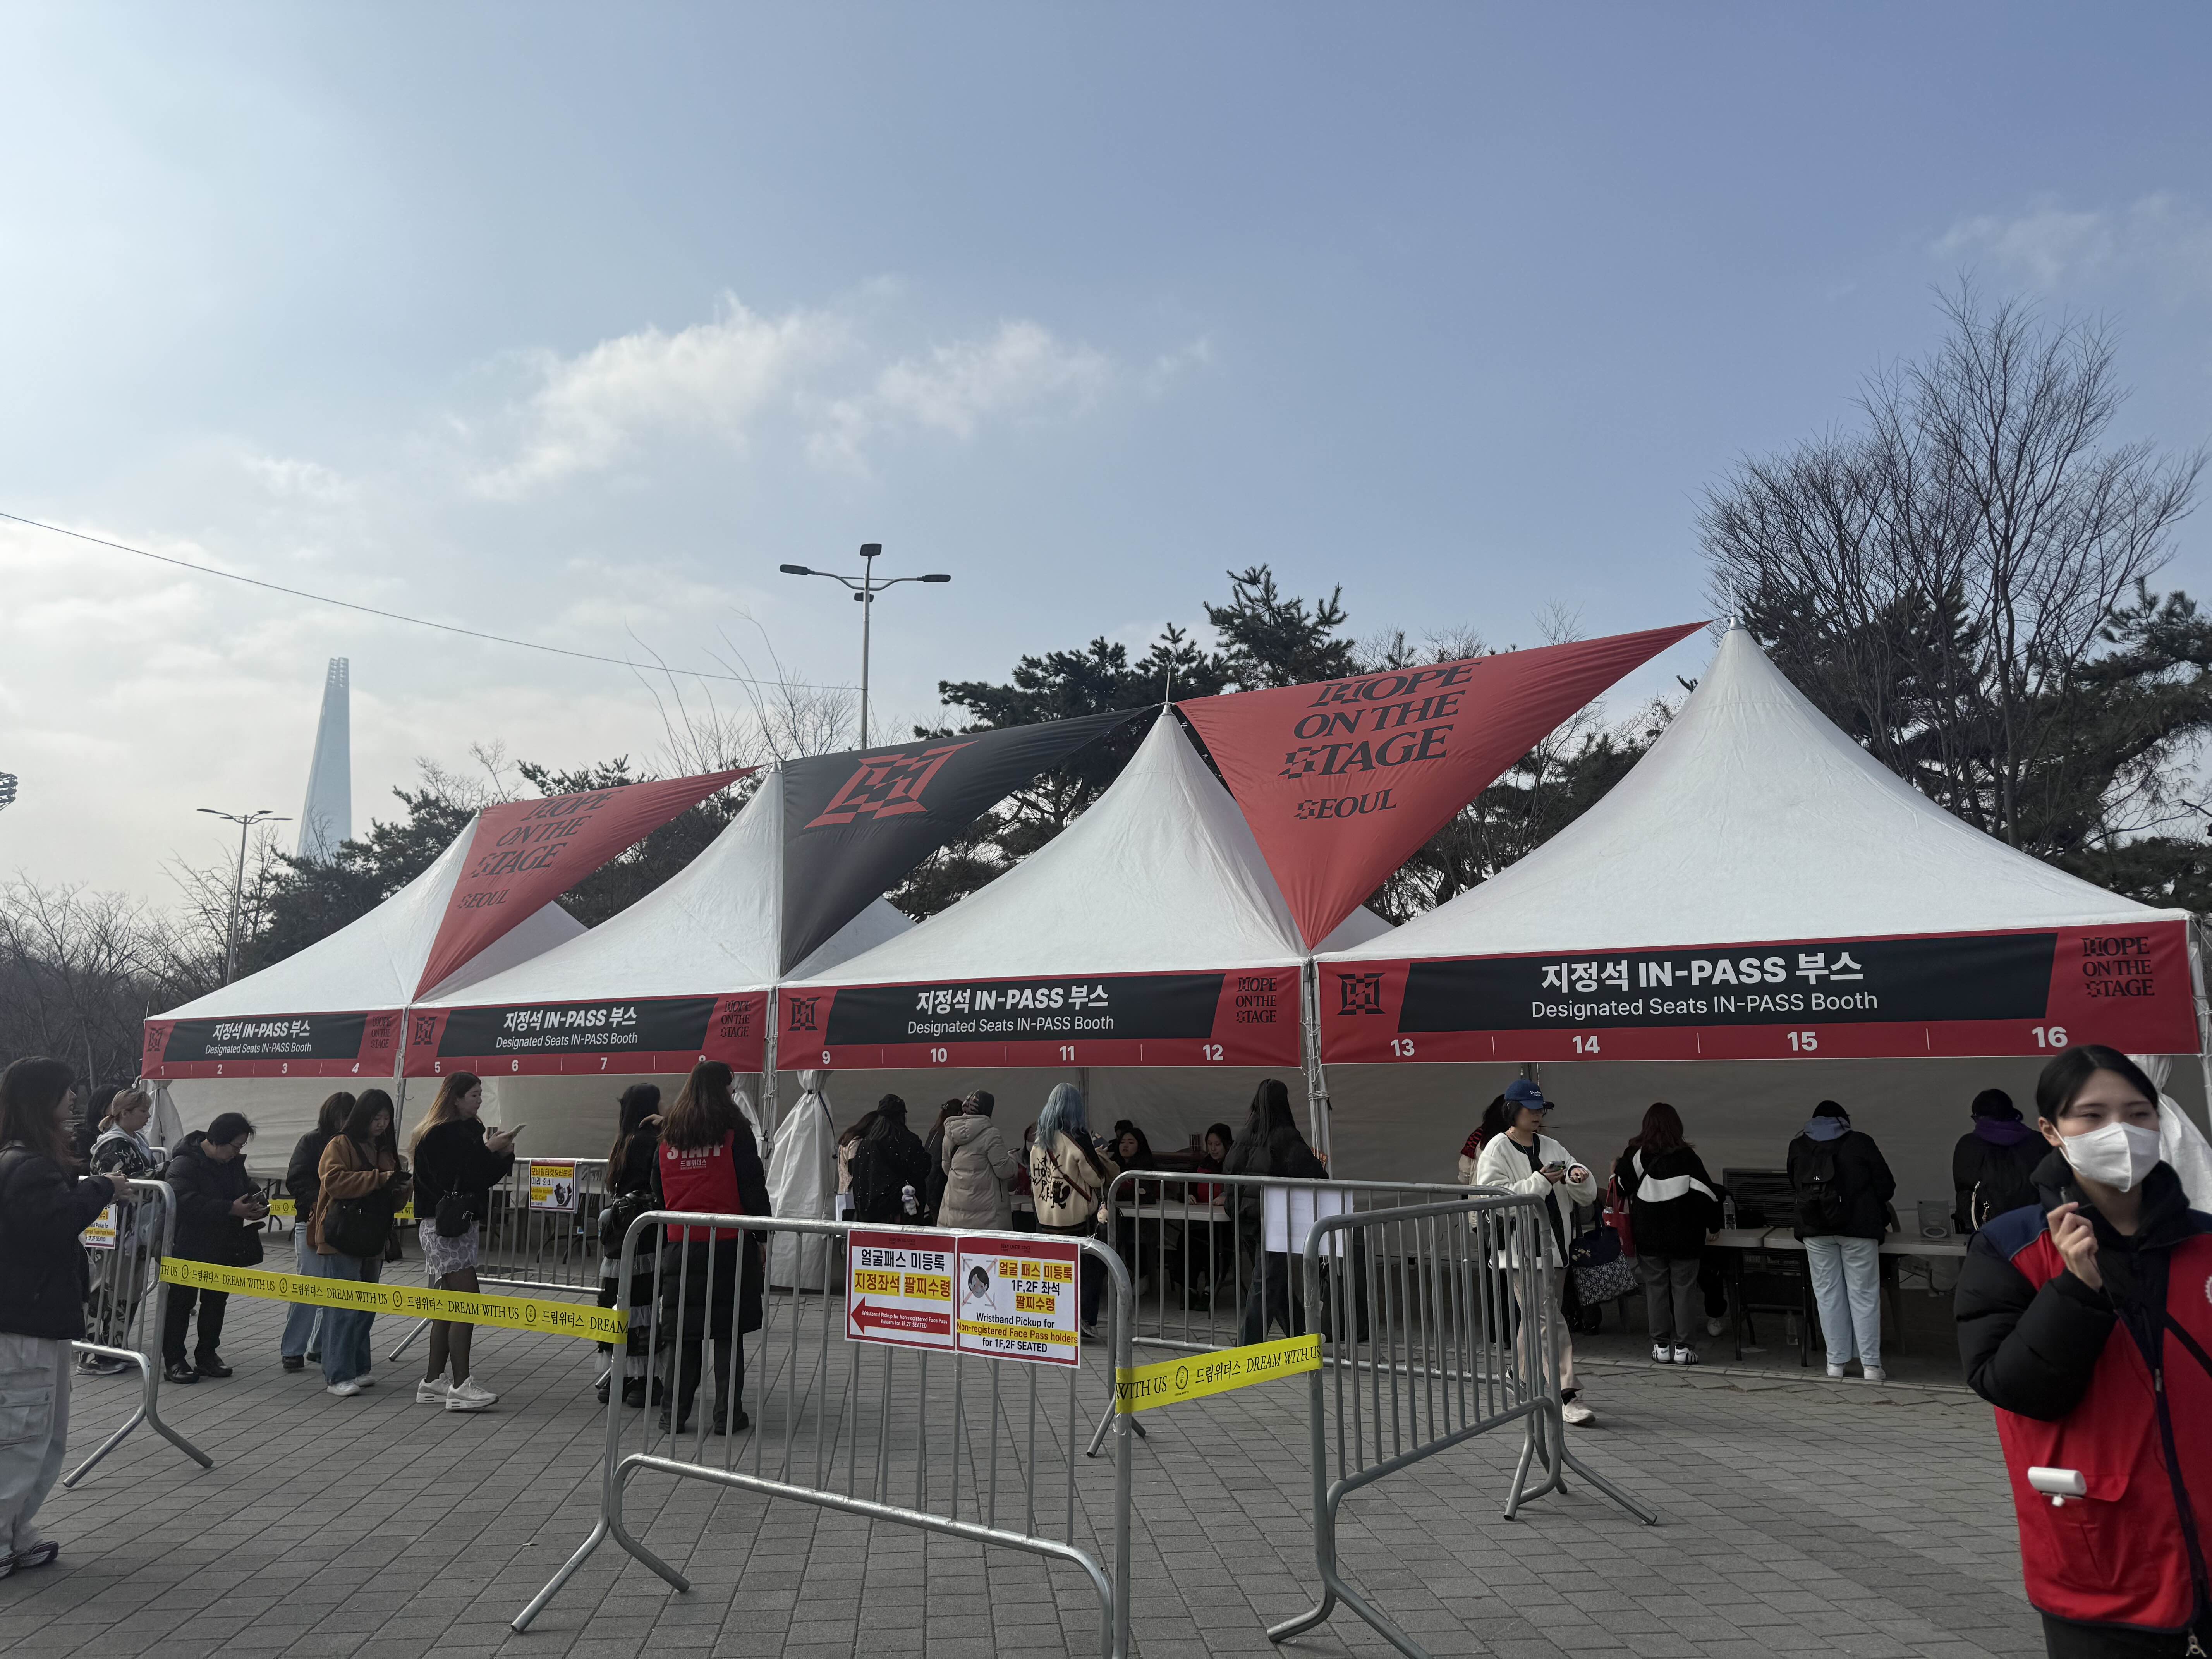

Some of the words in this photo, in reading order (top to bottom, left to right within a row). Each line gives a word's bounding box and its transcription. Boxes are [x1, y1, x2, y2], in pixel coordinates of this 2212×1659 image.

[1294, 709, 1367, 739] ON
[1370, 690, 1465, 731] THE
[1278, 724, 1454, 779] STAGE
[1293, 789, 1397, 820] SEOUL
[496, 825, 542, 847] ON
[532, 816, 592, 842] THE
[471, 842, 568, 878] STAGE
[458, 889, 510, 909] SEOUL
[2080, 937, 2150, 957] HOPE
[1541, 960, 1628, 993] 지정석
[1638, 957, 1786, 987] IN-PASS
[1796, 952, 1864, 985] 부스
[2082, 960, 2111, 977] ON
[2113, 960, 2152, 975] THE
[1237, 977, 1277, 992] HOPE
[2085, 979, 2155, 998] STAGE
[916, 989, 970, 1015] 지정석
[975, 988, 1064, 1010] IN-PASS
[1068, 985, 1108, 1010] 부스
[1236, 995, 1252, 1007] ON
[1254, 995, 1277, 1006] THE
[1532, 999, 1642, 1020] Designated
[1650, 998, 1707, 1015] Seats
[1714, 993, 1804, 1013] IN-PASS
[1811, 992, 1877, 1010] Booth
[504, 1010, 543, 1032] 지정석
[544, 1009, 607, 1028] IN-PASS
[609, 1007, 637, 1027] 부스
[721, 1015, 733, 1024] ON
[734, 1015, 750, 1024] THE
[908, 1019, 975, 1036] Designated
[979, 1019, 1014, 1032] Seats
[1017, 1017, 1070, 1031] IN-PASS
[1075, 1016, 1114, 1029] Booth
[1236, 1010, 1277, 1023] STAGE
[213, 1022, 243, 1040] 지정석
[242, 1022, 289, 1037] IN-PASS
[290, 1020, 310, 1038] 부스
[380, 1029, 390, 1037] THE
[720, 1026, 749, 1037] STAGE
[206, 1044, 241, 1056] Designated
[242, 1044, 260, 1053] Seats
[262, 1042, 290, 1053] IN-PASS
[291, 1042, 311, 1052] Booth
[371, 1039, 389, 1048] STAGE
[496, 1036, 543, 1049] Designated
[545, 1034, 569, 1046] Seats
[571, 1033, 608, 1045] IN-PASS
[611, 1032, 637, 1044] Booth
[1391, 1039, 1415, 1056] 13
[1572, 1035, 1600, 1054] 14
[1786, 1032, 1818, 1051] 15
[2032, 1027, 2068, 1048] 16
[822, 1051, 831, 1065] 9
[930, 1048, 948, 1063] 10
[1060, 1046, 1075, 1061] 11
[1203, 1044, 1224, 1061] 12
[161, 1066, 164, 1075] 1
[217, 1065, 222, 1074] 2
[282, 1063, 287, 1074] 3
[352, 1063, 359, 1073] 4
[434, 1061, 440, 1073] 5
[512, 1059, 518, 1072] 6
[601, 1058, 607, 1070] 7
[862, 1249, 906, 1267] 얼굴패스
[911, 1252, 945, 1272] 미등록
[1000, 1261, 1018, 1276] 얼굴
[1022, 1264, 1040, 1277] 패스
[1044, 1266, 1072, 1280] 미등록
[855, 1273, 900, 1292] 지정좌석
[905, 1276, 950, 1297] 팔찌수령
[1012, 1280, 1038, 1293] 1F,2F
[1041, 1281, 1060, 1296] 좌석
[170, 1266, 177, 1277] US
[192, 1270, 219, 1283] 드림위더스
[222, 1274, 246, 1287] DREAM
[247, 1278, 265, 1290] WITH
[266, 1280, 275, 1291] US
[292, 1283, 323, 1297] 드림위더스
[327, 1288, 354, 1301] DREAM
[356, 1291, 376, 1304] WITH
[378, 1293, 388, 1304] US
[407, 1296, 443, 1311] 드림위더스
[448, 1300, 479, 1315] DREAM
[481, 1304, 506, 1317] WITH
[508, 1307, 519, 1319] US
[542, 1310, 584, 1328] 드림위더스
[590, 1317, 628, 1333] DREAM
[1016, 1295, 1054, 1311] 팔찌수령
[976, 1312, 1013, 1324] Wristband
[1016, 1317, 1041, 1328] Pickup
[1044, 1319, 1054, 1328] for
[957, 1321, 1007, 1336] Non-registered
[1010, 1328, 1027, 1338] Face
[1030, 1330, 1048, 1340] Pass
[1051, 1332, 1078, 1343] holders
[982, 1337, 992, 1347] for
[995, 1339, 1015, 1350] 1F,2F
[1017, 1341, 1047, 1352] SEATED
[1116, 1379, 1150, 1400] WITH
[1154, 1376, 1167, 1394] US
[1195, 1360, 1241, 1384] 드림위더스
[1246, 1352, 1281, 1374] DREAM
[1284, 1346, 1310, 1364] WITH
[1310, 1345, 1321, 1358] US
